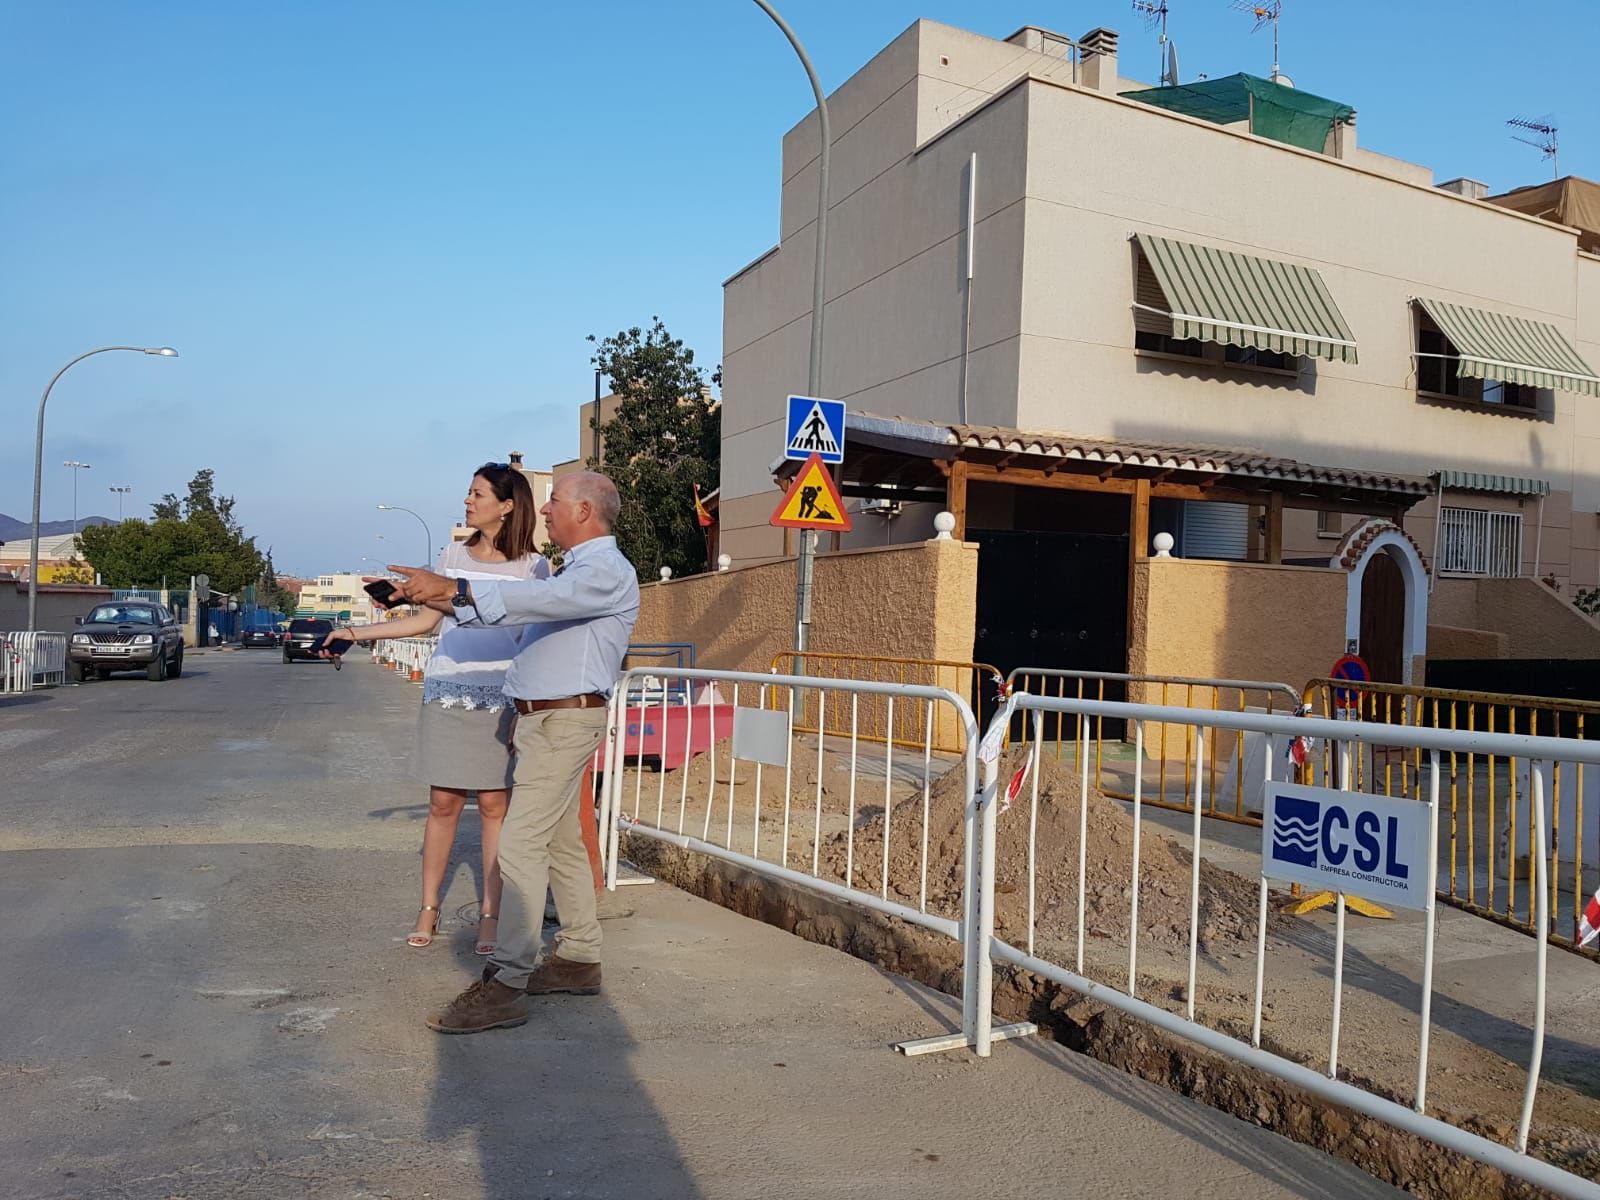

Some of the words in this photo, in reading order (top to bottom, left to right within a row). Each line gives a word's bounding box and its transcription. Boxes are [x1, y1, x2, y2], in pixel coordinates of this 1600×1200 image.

[1321, 805, 1409, 879] CSL
[1320, 864, 1350, 877] EMPRESA
[1351, 871, 1409, 891] CONSTRUCTORA
